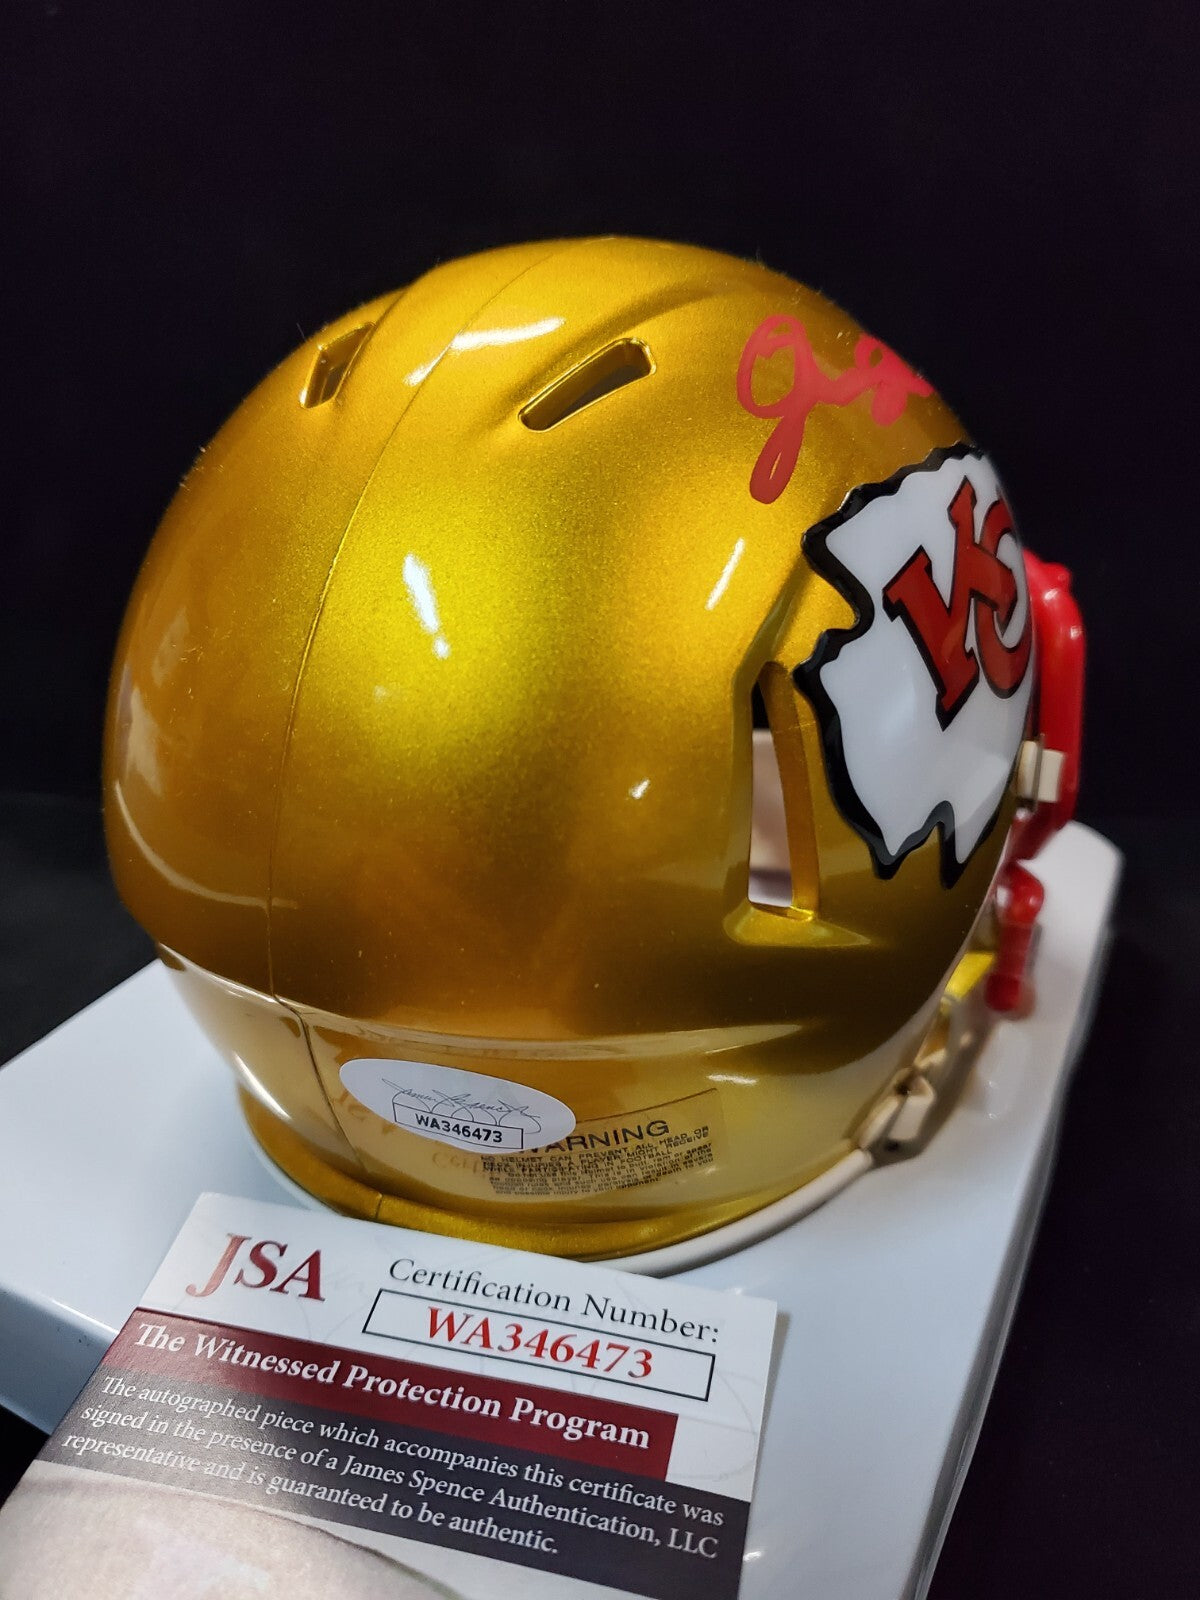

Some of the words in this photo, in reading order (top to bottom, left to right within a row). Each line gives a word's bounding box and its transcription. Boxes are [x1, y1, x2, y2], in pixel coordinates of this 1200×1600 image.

[415, 1113, 503, 1143] WA346473
[519, 1120, 669, 1153] ARNING
[185, 1232, 325, 1302] JSA
[389, 1257, 571, 1312] Certification
[580, 1293, 719, 1343] Number:
[427, 1306, 653, 1379] WA346473
[134, 1322, 186, 1353] The
[193, 1333, 341, 1385] Witnessed
[344, 1365, 502, 1418] Protection
[509, 1397, 651, 1450] Program
[62, 1434, 200, 1472] representative
[204, 1460, 242, 1480] and
[247, 1466, 265, 1484] is
[266, 1473, 387, 1514] guaranteed
[391, 1498, 413, 1520] to
[417, 1502, 445, 1526] be
[448, 1514, 559, 1554] authentic.
[81, 1403, 148, 1431] signed
[150, 1416, 170, 1434] in
[173, 1421, 206, 1442] the
[207, 1431, 297, 1461] presence
[301, 1445, 330, 1466] of
[325, 1457, 338, 1471] a
[339, 1455, 405, 1484] James
[408, 1469, 485, 1503] Spence
[489, 1488, 661, 1547] Authentication,
[667, 1528, 719, 1559] LLC
[102, 1376, 137, 1399] The
[138, 1387, 260, 1424] autographed
[261, 1410, 314, 1435] piece
[319, 1423, 379, 1449] which
[384, 1437, 518, 1478] accompanies
[523, 1463, 564, 1489] this
[569, 1476, 676, 1515] certificate
[684, 1504, 724, 1527] was
